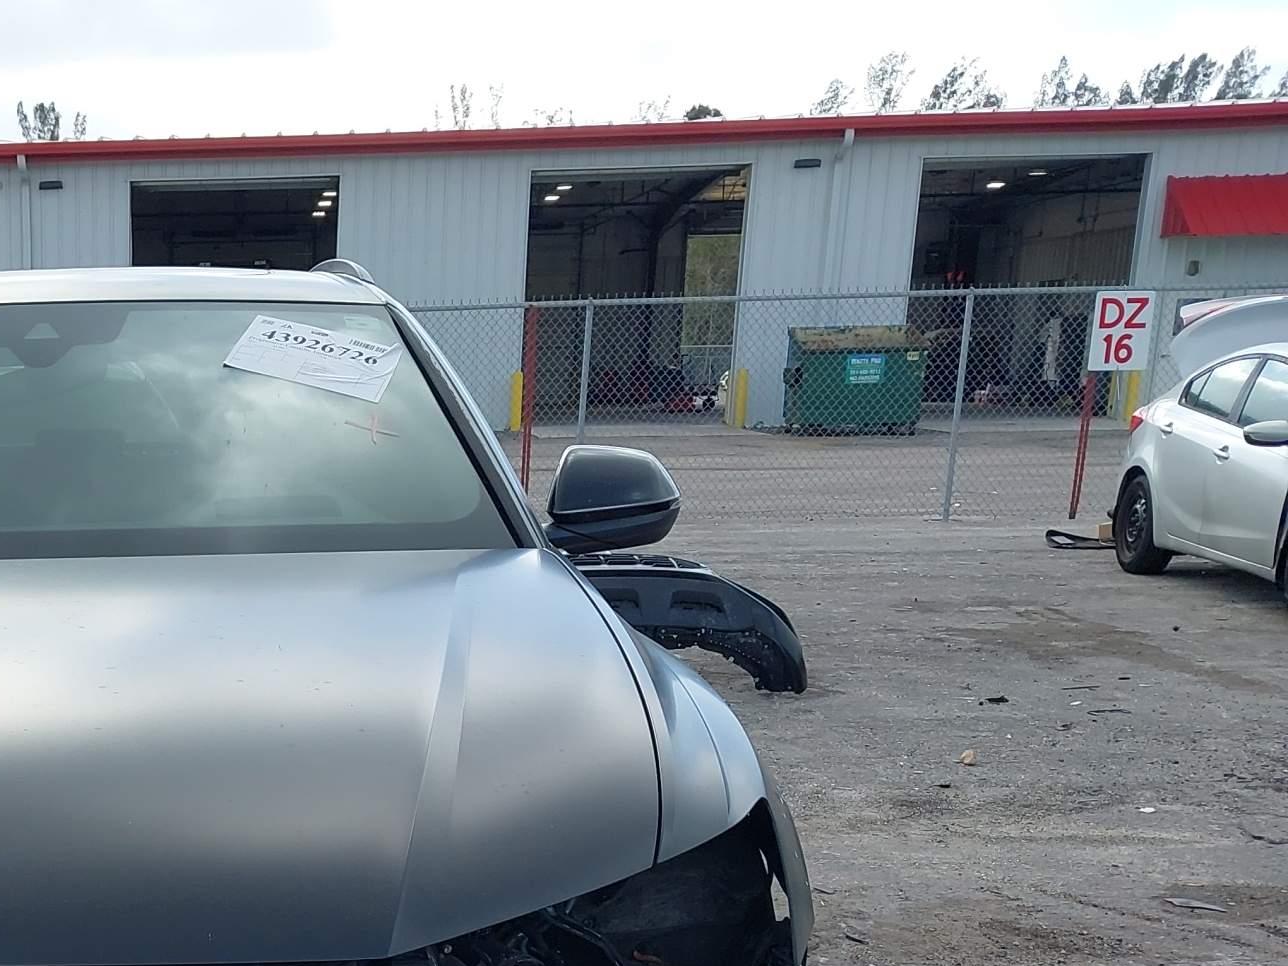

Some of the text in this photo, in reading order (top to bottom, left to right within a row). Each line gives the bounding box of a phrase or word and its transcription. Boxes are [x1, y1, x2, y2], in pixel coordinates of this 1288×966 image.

[1099, 297, 1150, 329] DZ
[261, 330, 378, 366] 43926726
[1103, 333, 1134, 364] 16
